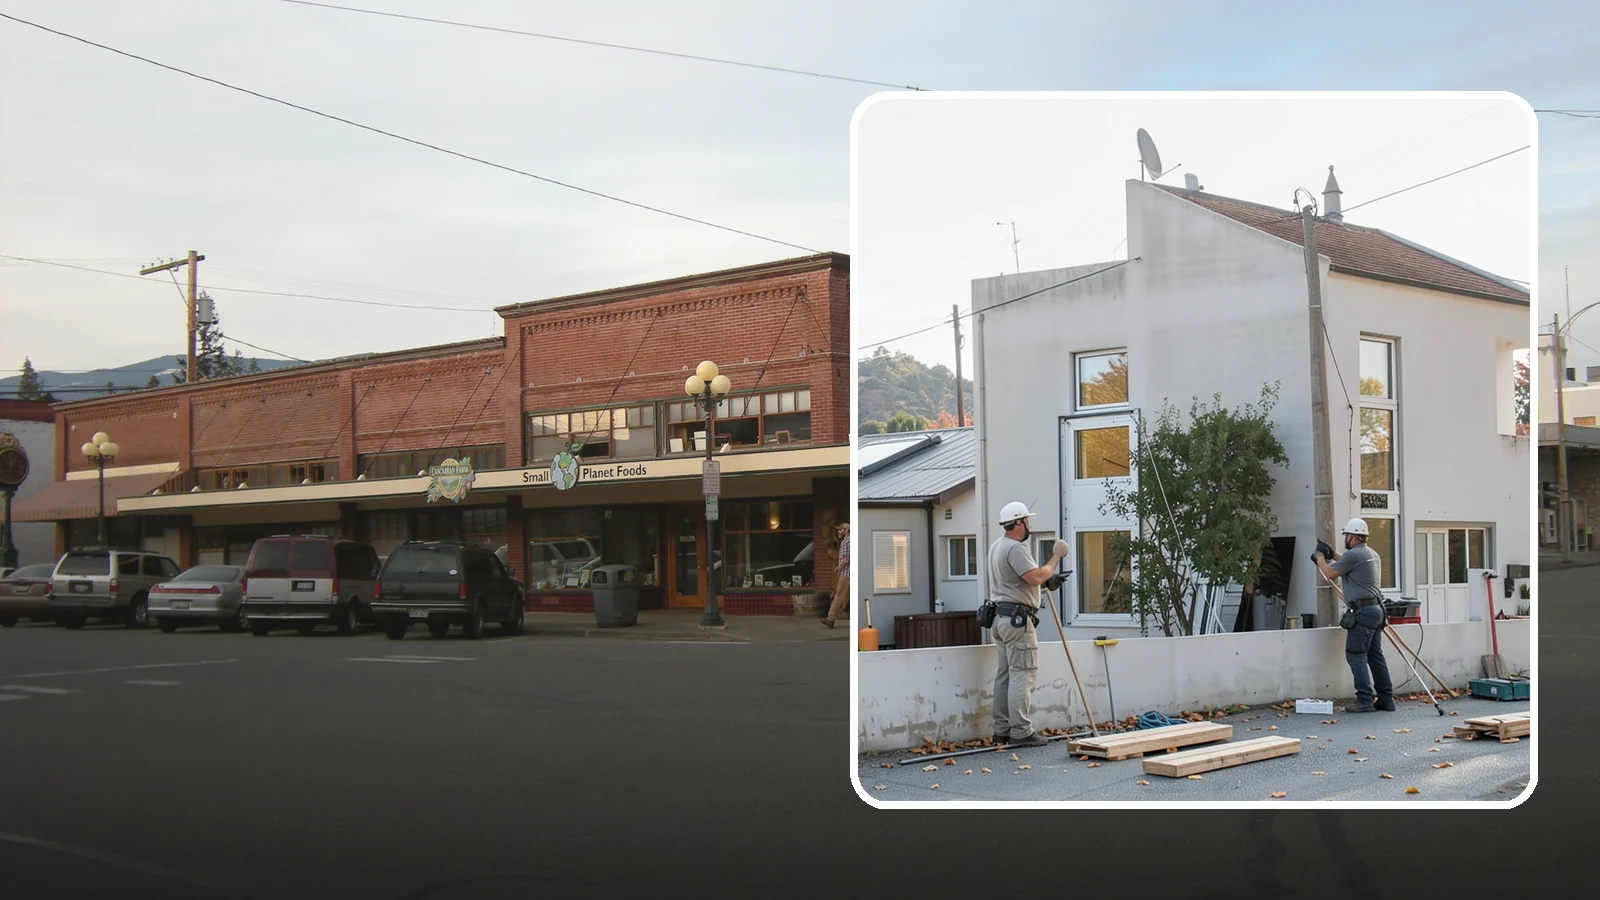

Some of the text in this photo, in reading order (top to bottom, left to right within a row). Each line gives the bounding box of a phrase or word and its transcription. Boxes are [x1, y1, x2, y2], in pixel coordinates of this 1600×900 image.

[523, 464, 647, 483] Small Planet Foods
